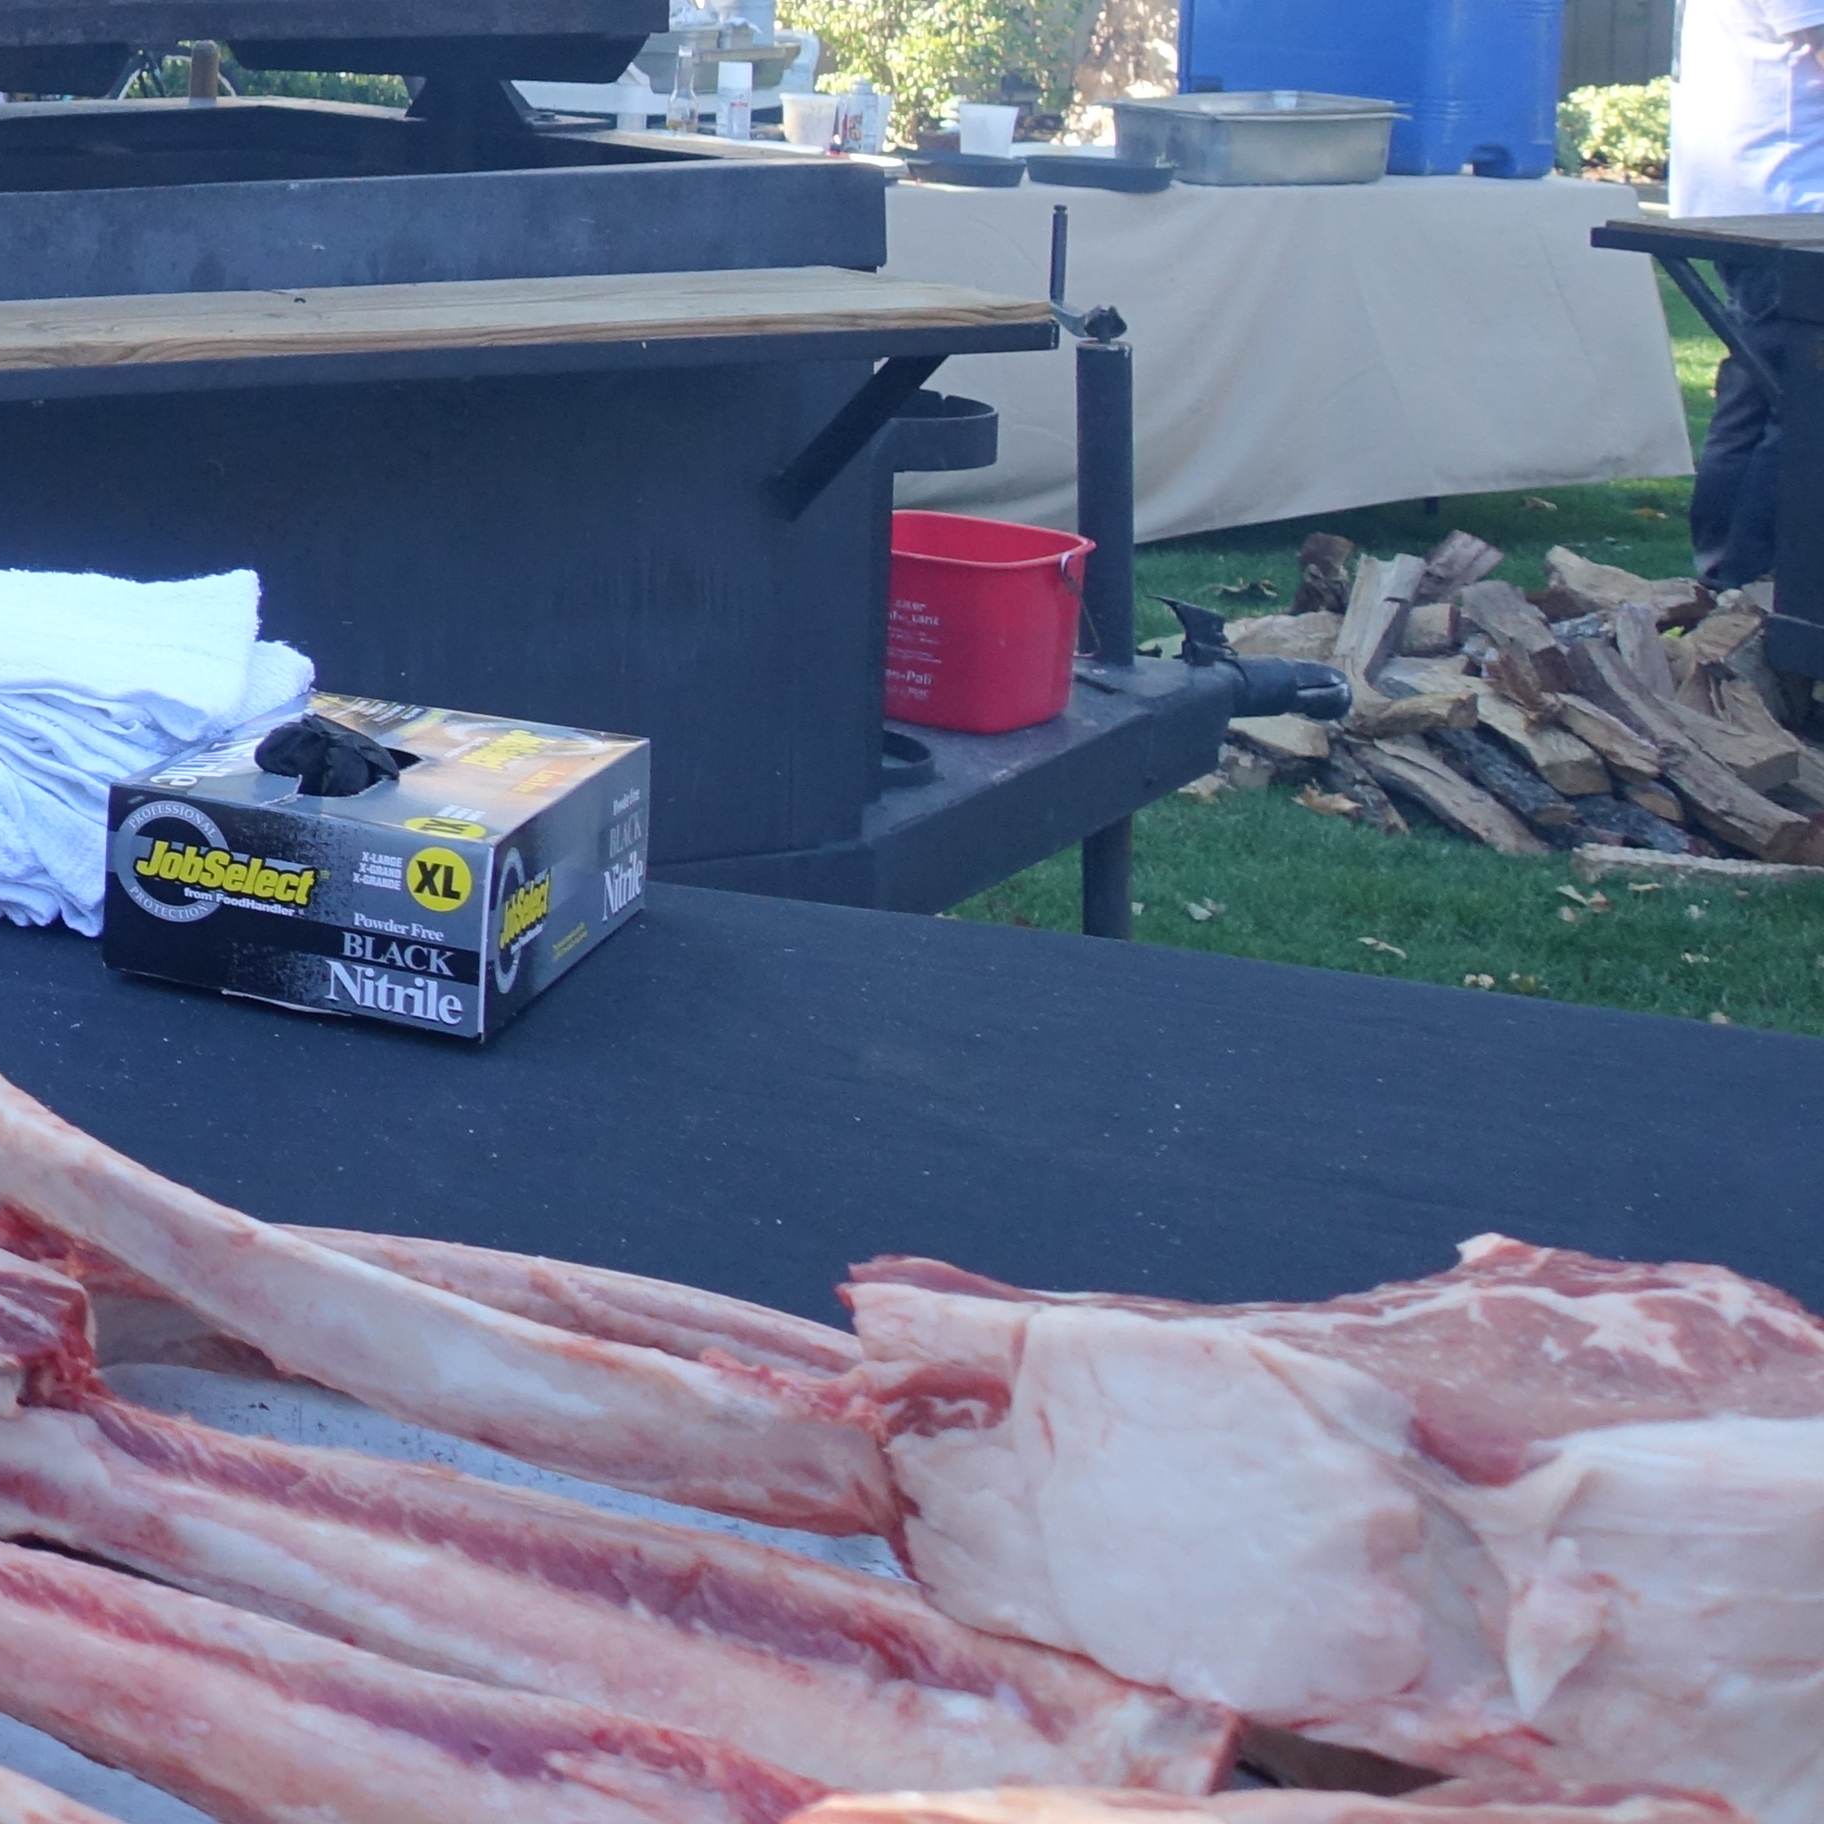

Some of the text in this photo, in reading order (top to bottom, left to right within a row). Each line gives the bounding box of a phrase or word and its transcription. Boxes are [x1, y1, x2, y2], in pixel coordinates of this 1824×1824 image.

[128, 804, 217, 838] PROFESSIONAL
[136, 840, 315, 905] JobSelect
[362, 851, 403, 866] X-LARGE
[414, 860, 462, 900] XL
[602, 850, 644, 922] Nitrile
[130, 886, 209, 919] PROTECTION
[184, 888, 296, 916] from FoodHandler
[354, 912, 444, 942] Powder Free
[341, 931, 455, 977] BLACK
[324, 959, 463, 1025] Nitrile
